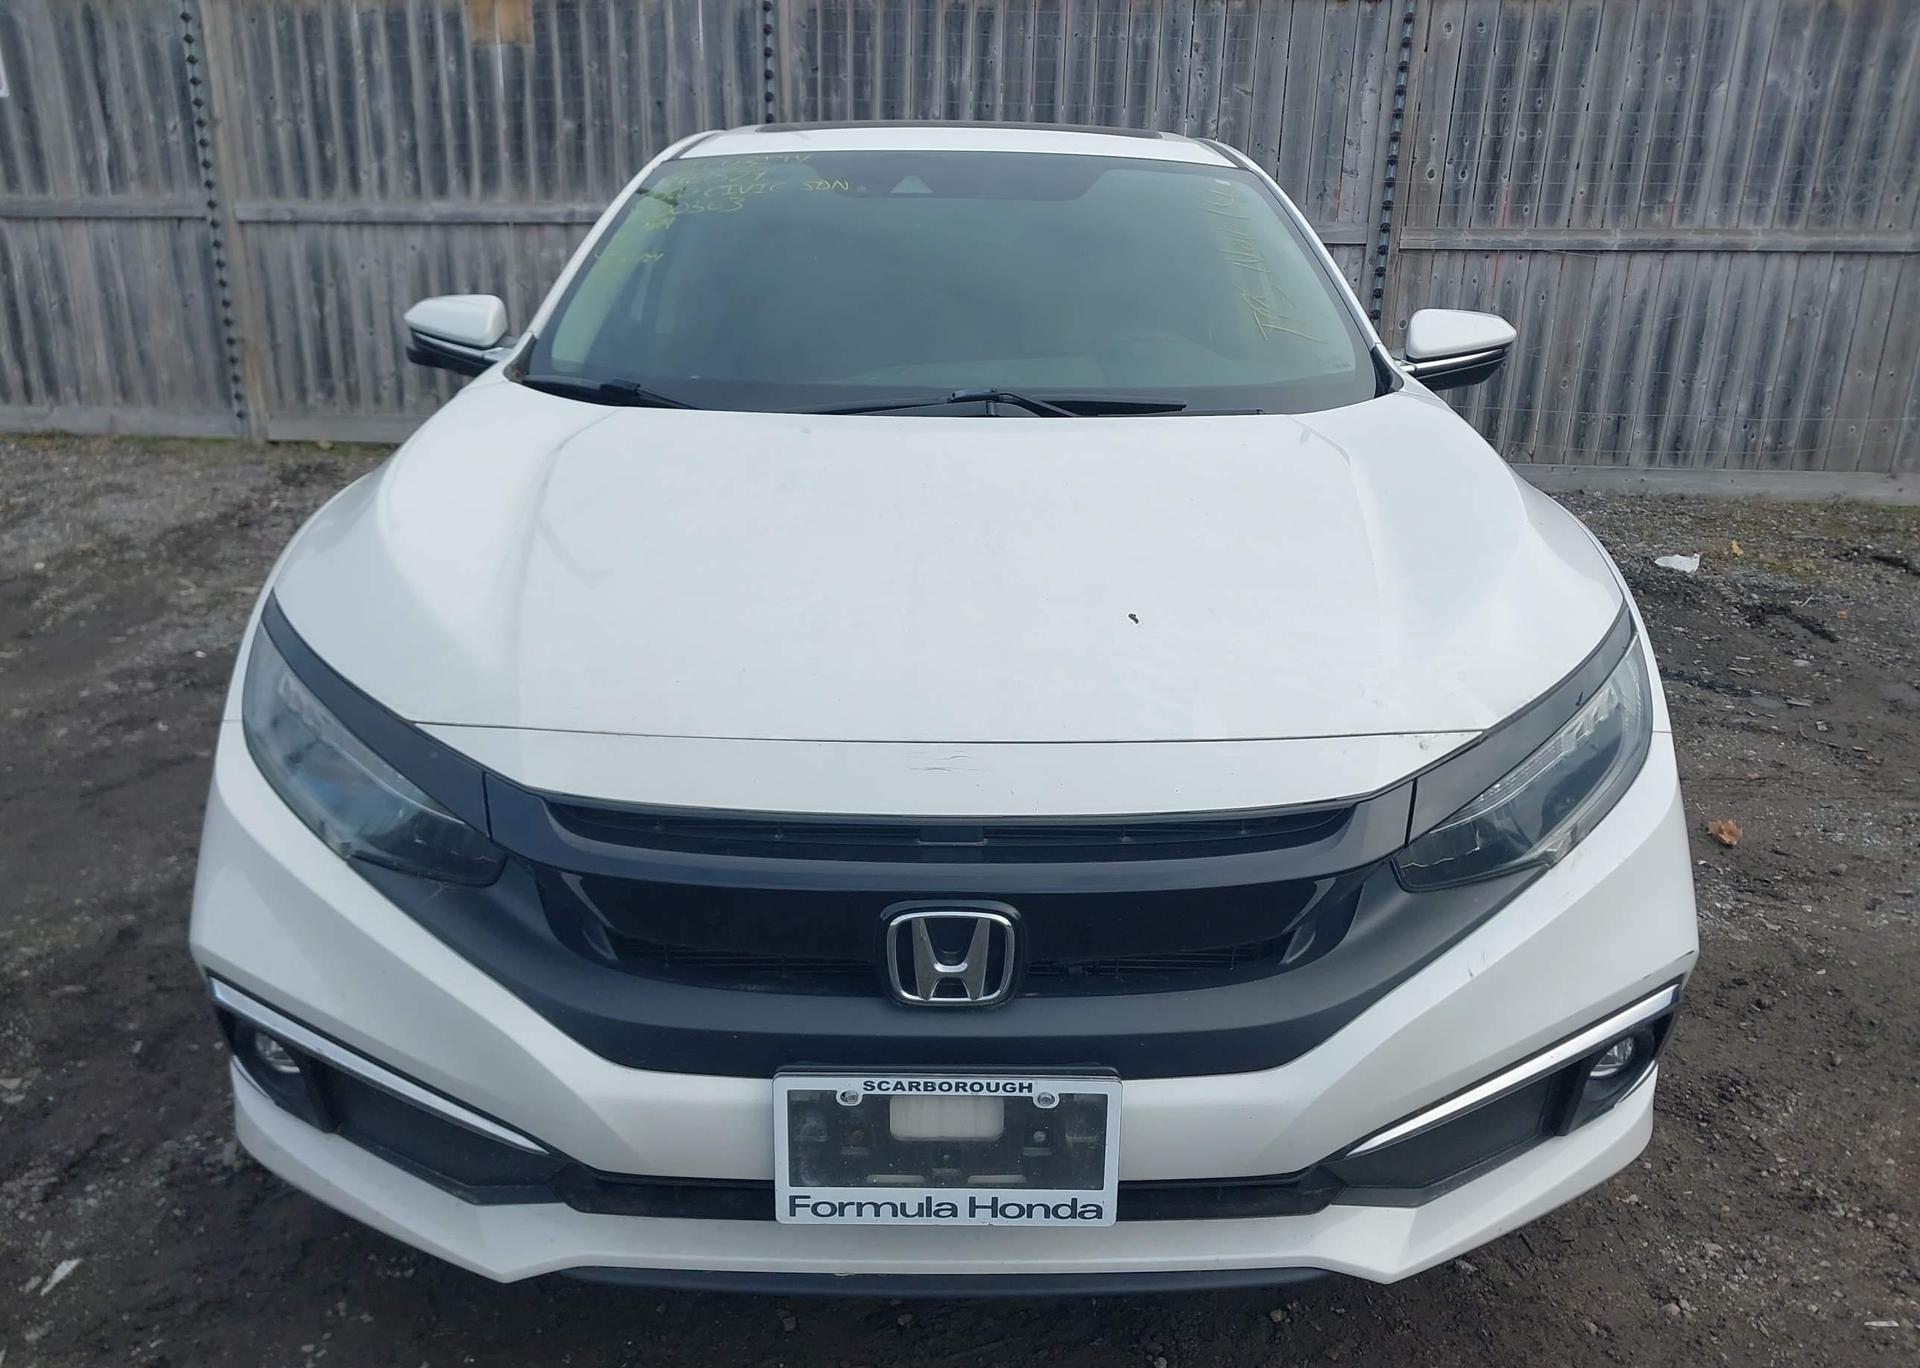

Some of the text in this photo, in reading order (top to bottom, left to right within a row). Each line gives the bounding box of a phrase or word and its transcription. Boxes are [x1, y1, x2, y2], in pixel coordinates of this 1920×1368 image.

[704, 182, 787, 196] CIVIC
[863, 1079, 1033, 1094] SCARBOROUGH
[788, 1194, 1104, 1220] Formula Honda
